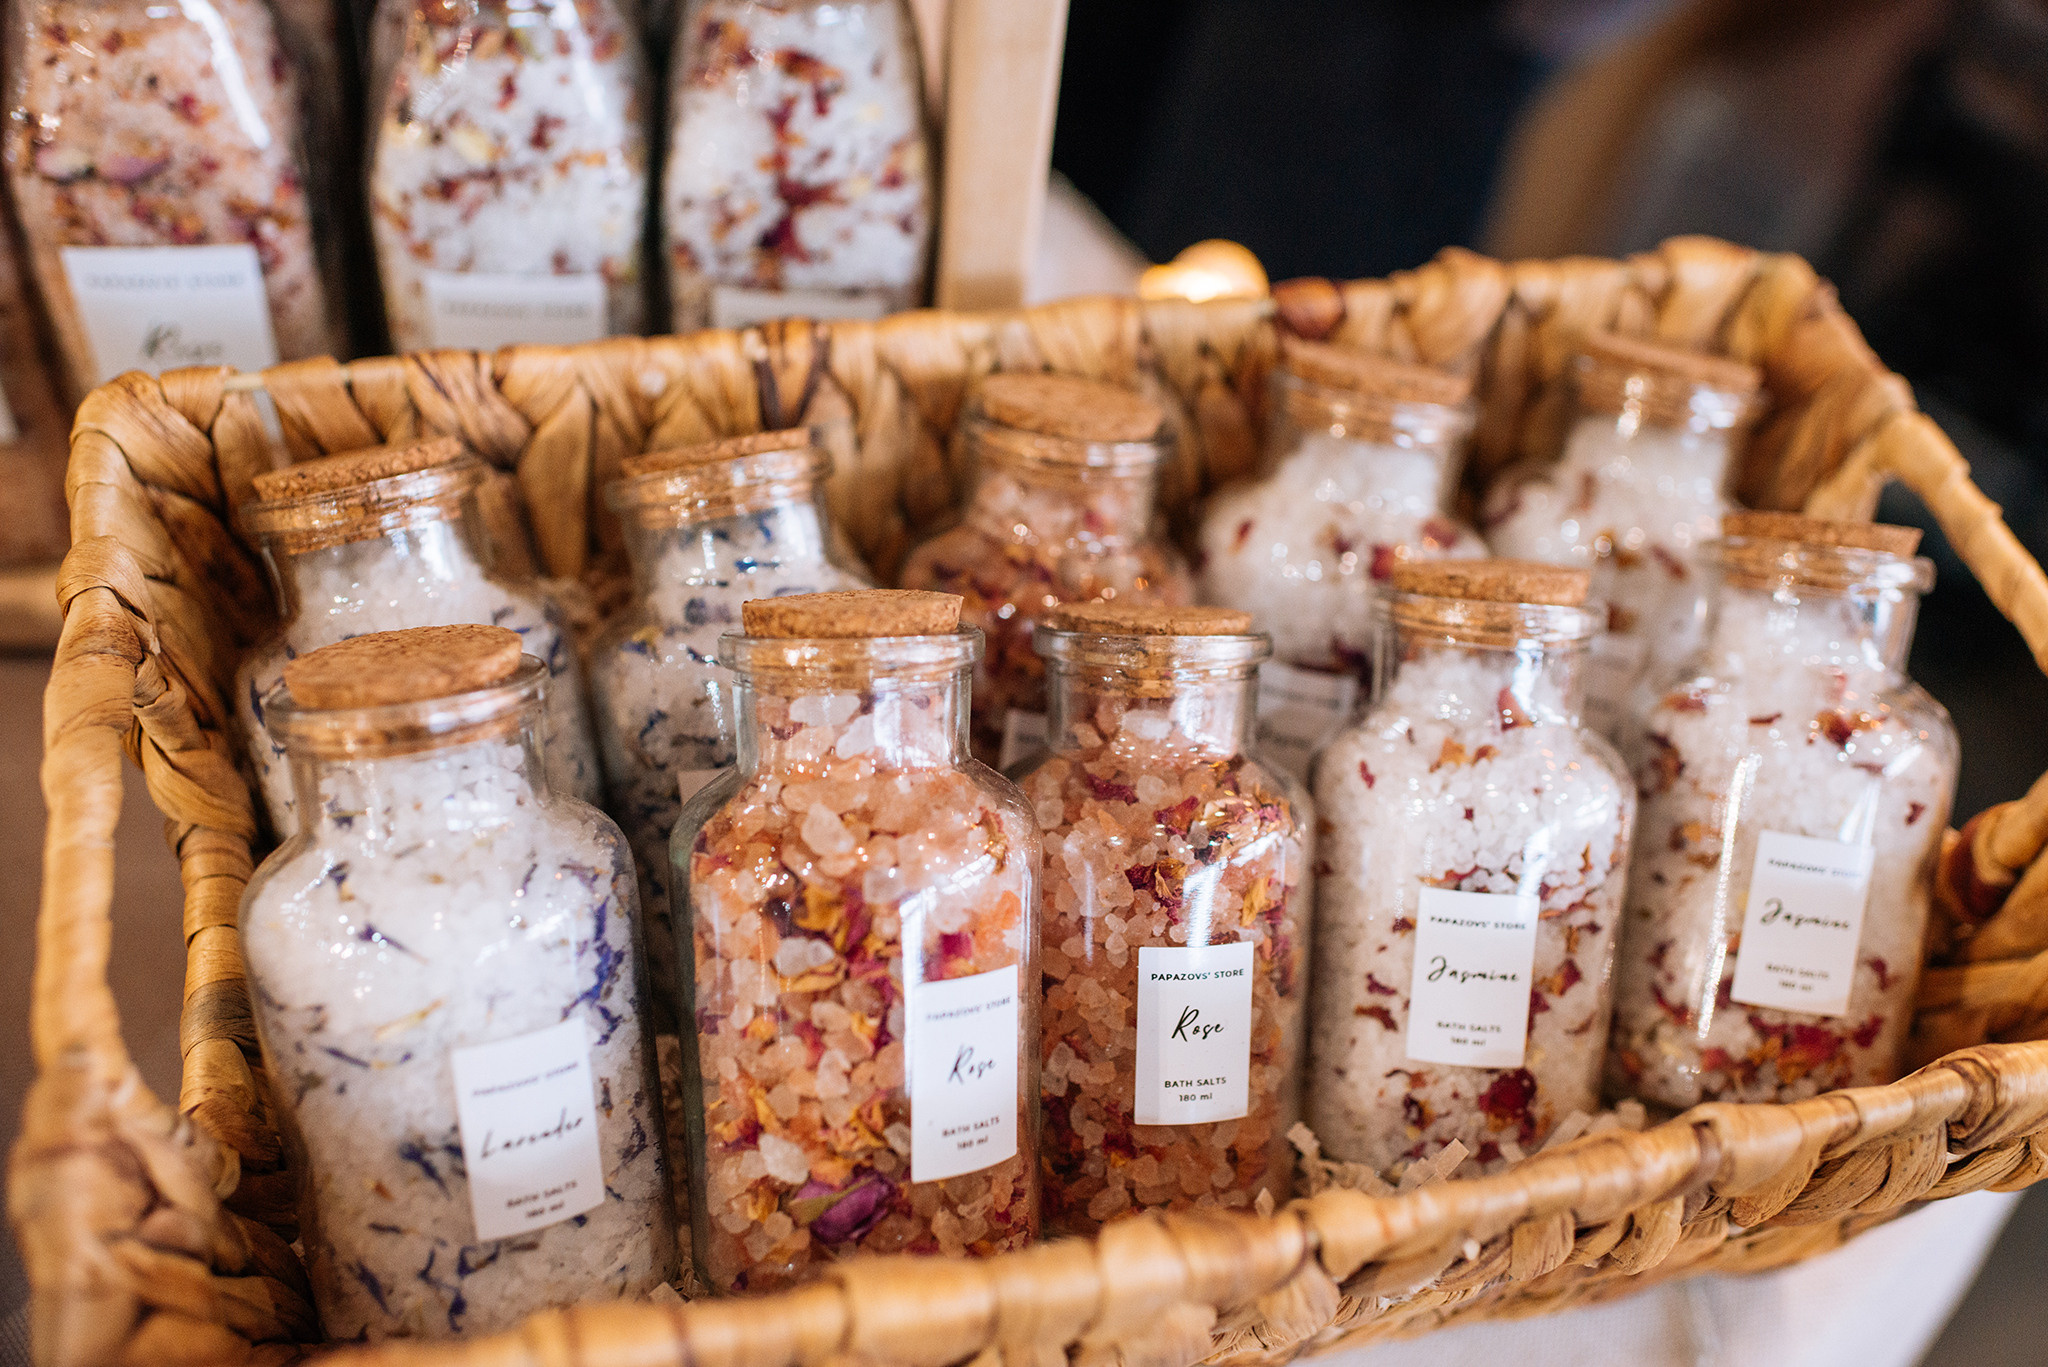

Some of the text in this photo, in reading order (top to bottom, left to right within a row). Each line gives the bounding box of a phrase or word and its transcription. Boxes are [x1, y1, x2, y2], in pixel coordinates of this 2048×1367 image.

[1760, 897, 1850, 929] Jasmine
[1430, 915, 1527, 931] PAPAZOVS' STORE
[1151, 968, 1245, 981] PAPAZOVS' STORE
[1427, 955, 1520, 984] Jasmine
[1766, 962, 1794, 975] BATH
[986, 996, 1013, 1011] STORE
[1171, 1005, 1225, 1042] Rose
[1436, 1020, 1502, 1033] BATH SALTS
[1450, 1036, 1487, 1047] 180 ml
[948, 1043, 996, 1085] Rose
[1164, 1076, 1227, 1089] BATH SALTS
[1179, 1091, 1214, 1102] 180 ml
[942, 1115, 1001, 1137] BATH SALTS
[956, 1135, 989, 1151] 180 ml
[506, 1180, 577, 1209] BATH SALTS
